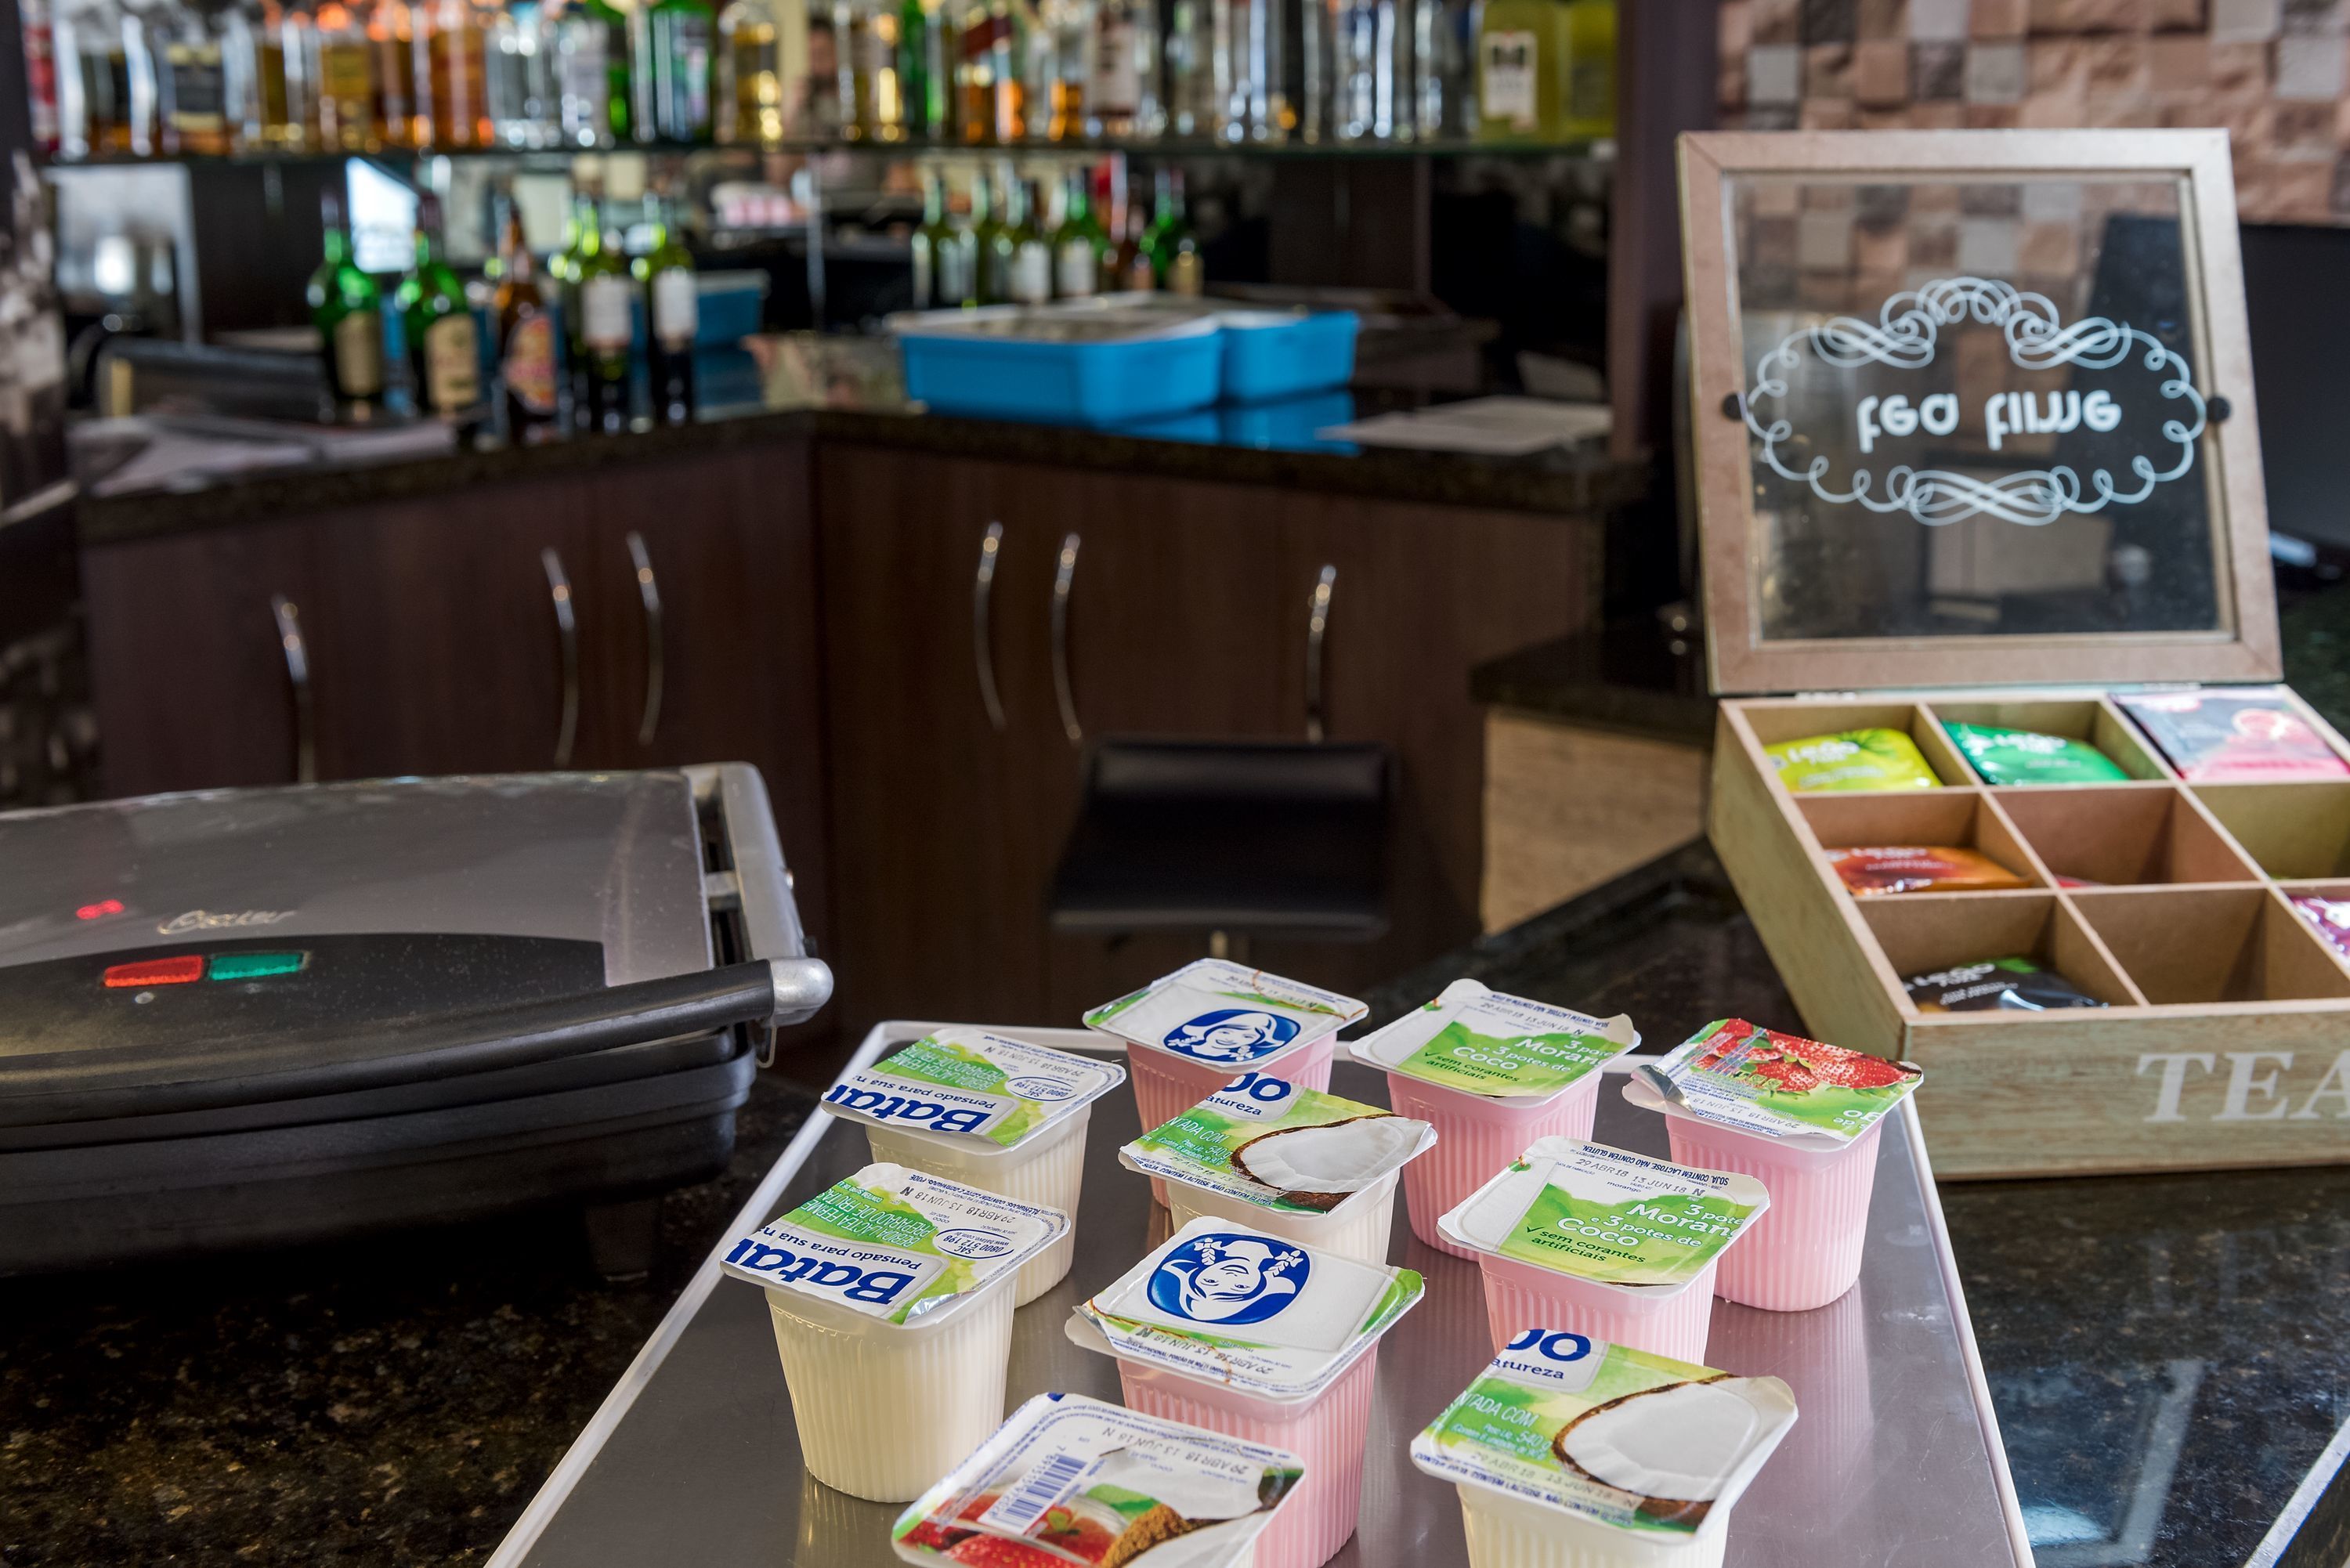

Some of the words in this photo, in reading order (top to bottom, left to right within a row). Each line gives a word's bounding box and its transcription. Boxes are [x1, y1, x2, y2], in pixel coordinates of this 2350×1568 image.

[1564, 1039, 1582, 1050] 3
[1492, 1046, 1506, 1055] 3
[1504, 1052, 1549, 1068] potes
[1550, 1062, 1573, 1072] de
[1425, 1059, 1488, 1081] artificiais
[1436, 1054, 1464, 1068] sem
[1464, 1064, 1520, 1082] corantes
[869, 1079, 897, 1090] sua
[898, 1085, 934, 1097] para
[2135, 1049, 2350, 1122] TEA
[1198, 1129, 1231, 1144] COM
[1205, 1144, 1228, 1156] 540
[1608, 1151, 1636, 1165] CONTÉM
[1634, 1158, 1650, 1170] NÃO
[1651, 1162, 1682, 1177] LACTOSE.
[1681, 1170, 1710, 1183] CONTÉM
[1575, 1158, 1593, 1168] 29
[1591, 1162, 1617, 1175] ABR
[1614, 1169, 1629, 1178] 18
[1631, 1175, 1647, 1184] 13
[1647, 1180, 1673, 1190] JUN
[1672, 1185, 1687, 1194] 18
[1690, 1187, 1706, 1197] N
[1710, 1175, 1730, 1187] SOJA.
[898, 1186, 915, 1197] N
[1606, 1180, 1642, 1194] morango
[914, 1190, 930, 1203] 18
[926, 1196, 950, 1208] JUN
[857, 1204, 877, 1223] DE
[948, 1202, 964, 1212] 13
[966, 1206, 980, 1216] 18
[1683, 1203, 1705, 1217] 3
[872, 1208, 938, 1237] PREPARADO
[978, 1209, 1003, 1223] ABR
[1000, 1215, 1016, 1223] 29
[836, 1214, 884, 1237] LÁCTEA
[1603, 1215, 1625, 1227] 3
[1618, 1223, 1675, 1242] potes
[1676, 1235, 1703, 1248] de
[778, 1233, 809, 1248] sua
[879, 1227, 922, 1248] BEBIDA
[942, 1234, 963, 1245] 198
[960, 1240, 981, 1249] 512
[809, 1242, 851, 1259] para
[953, 1245, 975, 1255] SAC
[979, 1244, 1005, 1254] 0800
[1531, 1236, 1607, 1263] artificiais
[1539, 1229, 1574, 1244] sem
[1575, 1239, 1647, 1264] corantes
[1500, 1405, 1540, 1428] COM
[1135, 1437, 1164, 1452] JUN
[1200, 1456, 1229, 1472] ABR
